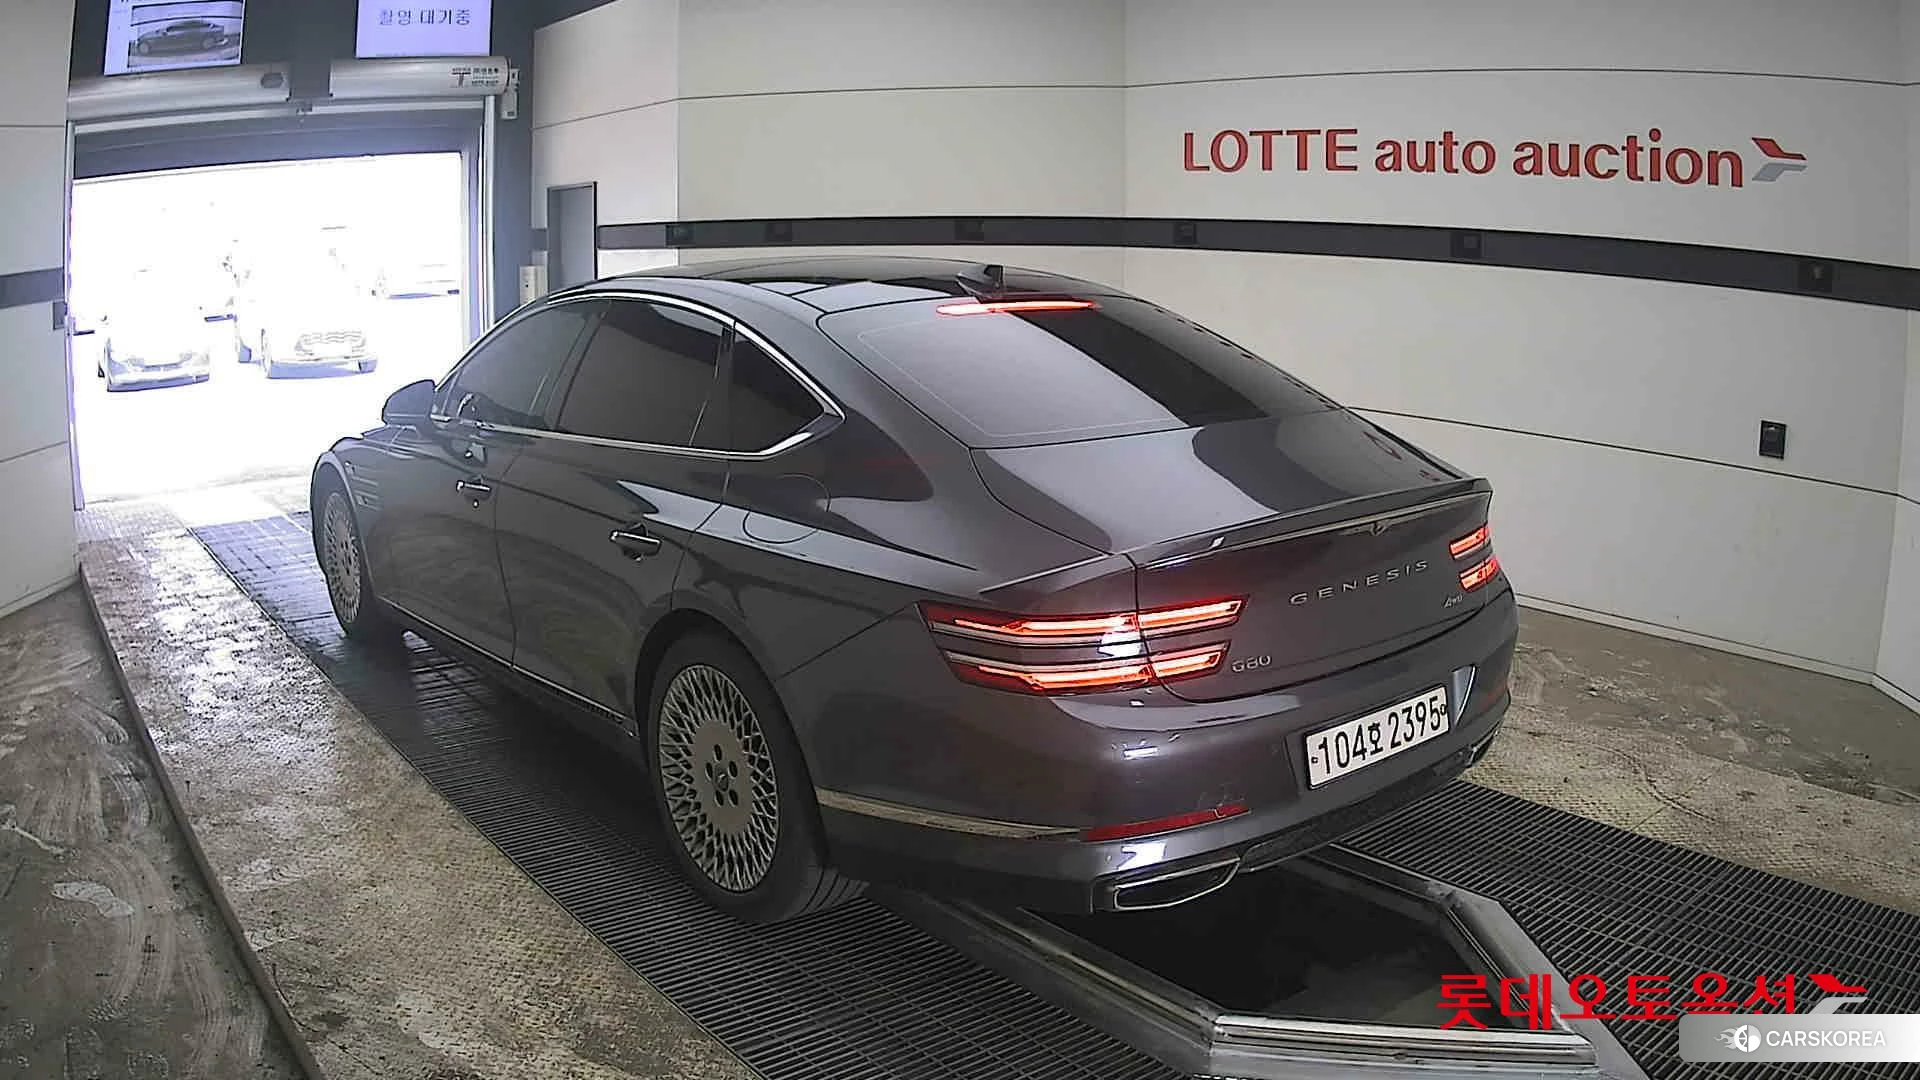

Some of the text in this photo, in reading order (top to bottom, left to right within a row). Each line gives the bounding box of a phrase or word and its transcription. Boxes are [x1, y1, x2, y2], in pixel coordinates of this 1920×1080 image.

[420, 9, 471, 26] 대기중
[1184, 128, 1743, 188] LOTTE auto auction
[1290, 560, 1429, 606] GENESIS
[1231, 655, 1271, 672] G80
[1318, 695, 1441, 775] 104호 2395
